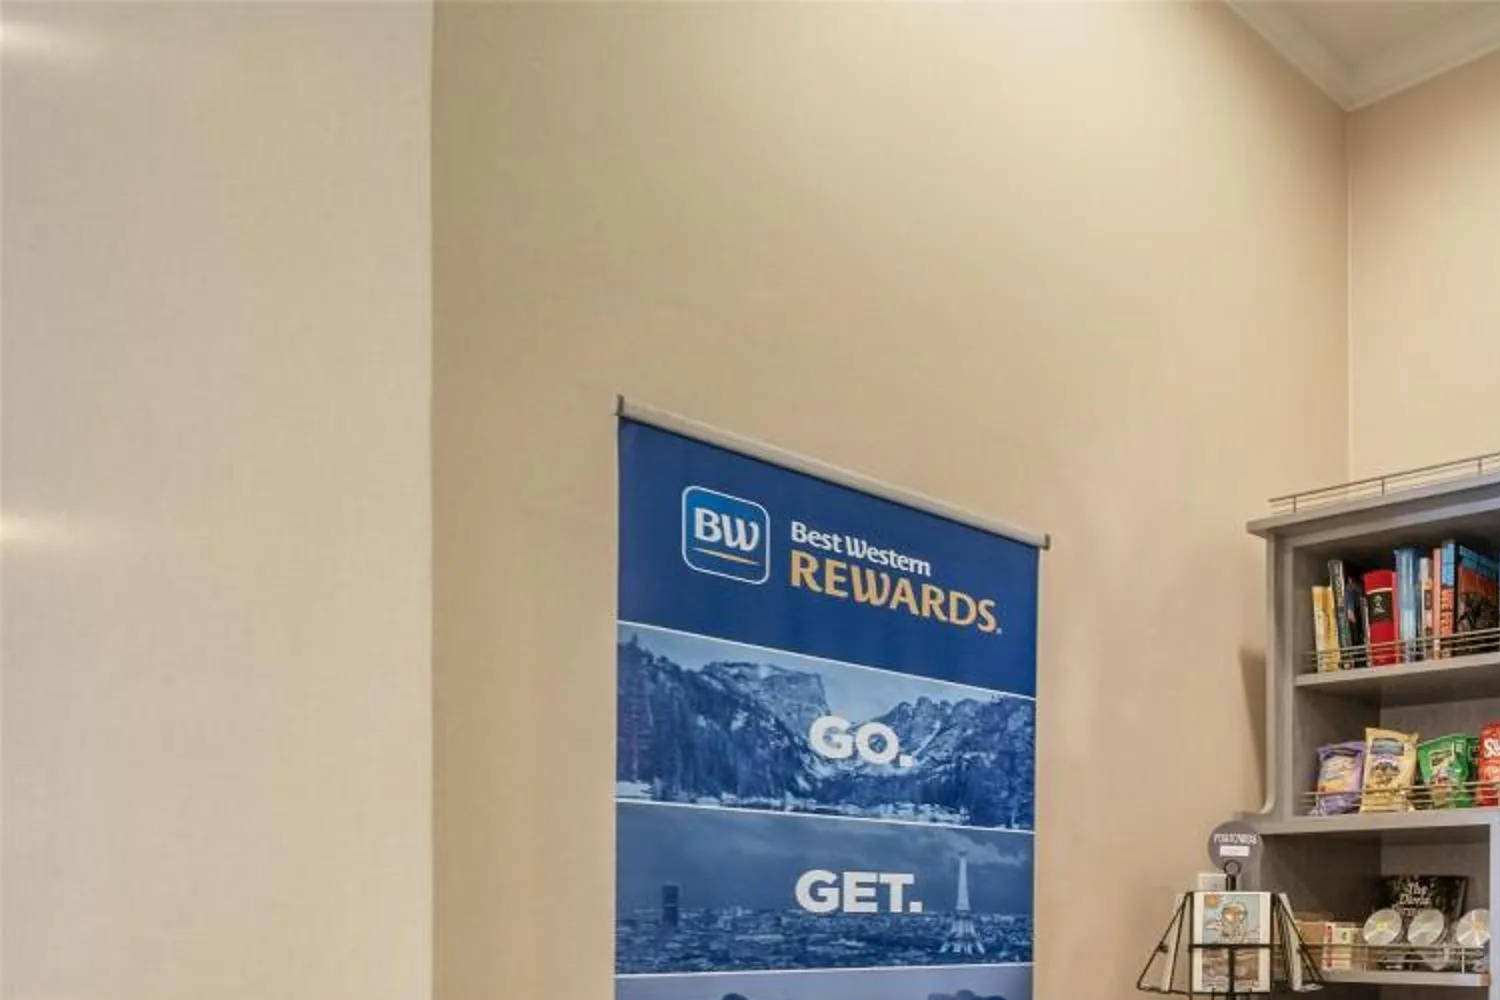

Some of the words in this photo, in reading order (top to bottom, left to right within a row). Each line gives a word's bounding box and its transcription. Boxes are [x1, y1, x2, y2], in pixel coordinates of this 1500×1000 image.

[695, 508, 759, 551] BW
[791, 522, 843, 554] Best
[845, 535, 931, 576] Western
[810, 716, 913, 767] GO.
[795, 870, 922, 913] GET.
